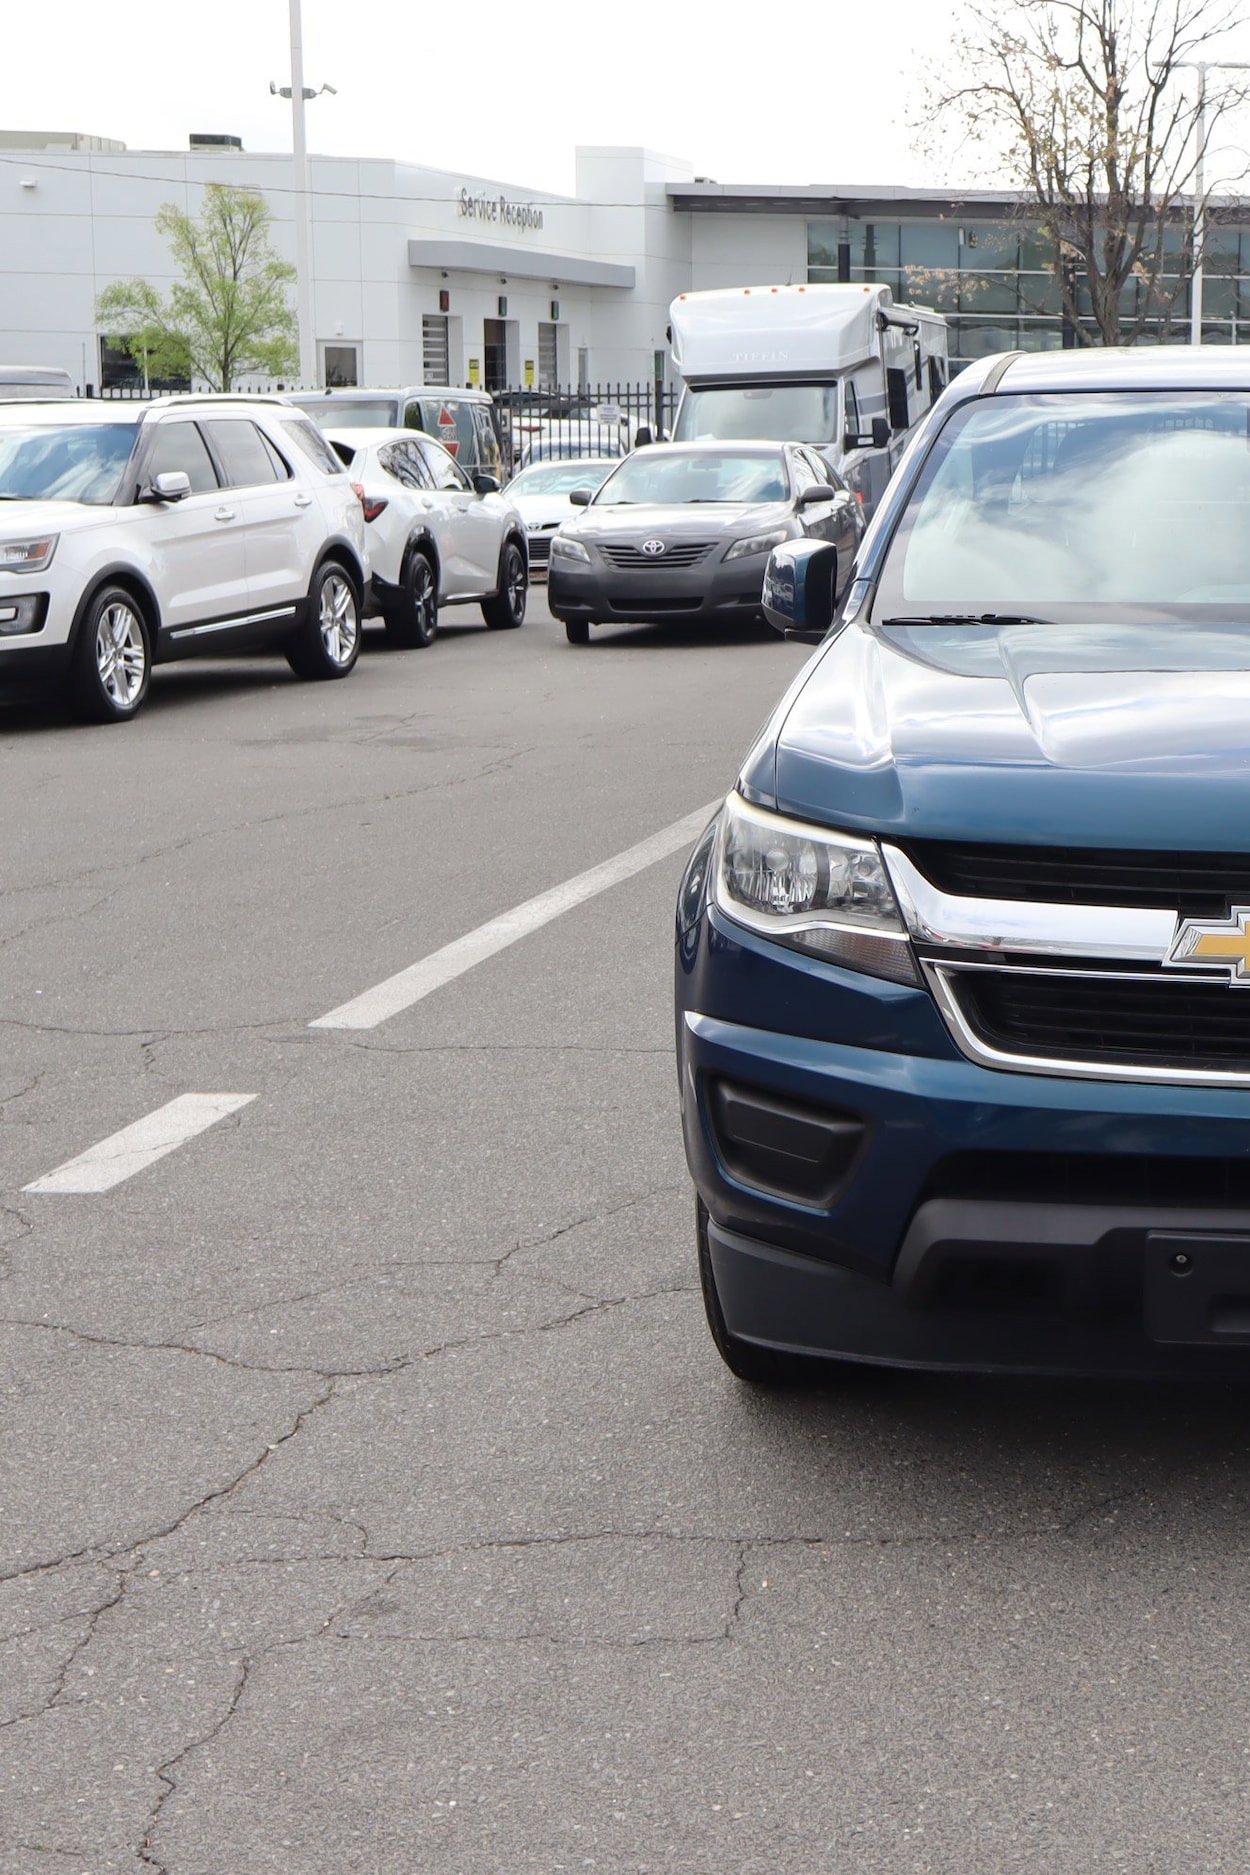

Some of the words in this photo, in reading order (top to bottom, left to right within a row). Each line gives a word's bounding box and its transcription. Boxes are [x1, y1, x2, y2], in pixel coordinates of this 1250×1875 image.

[460, 186, 498, 222] Service
[499, 195, 544, 234] Reception
[733, 351, 789, 362] TIFFIN
